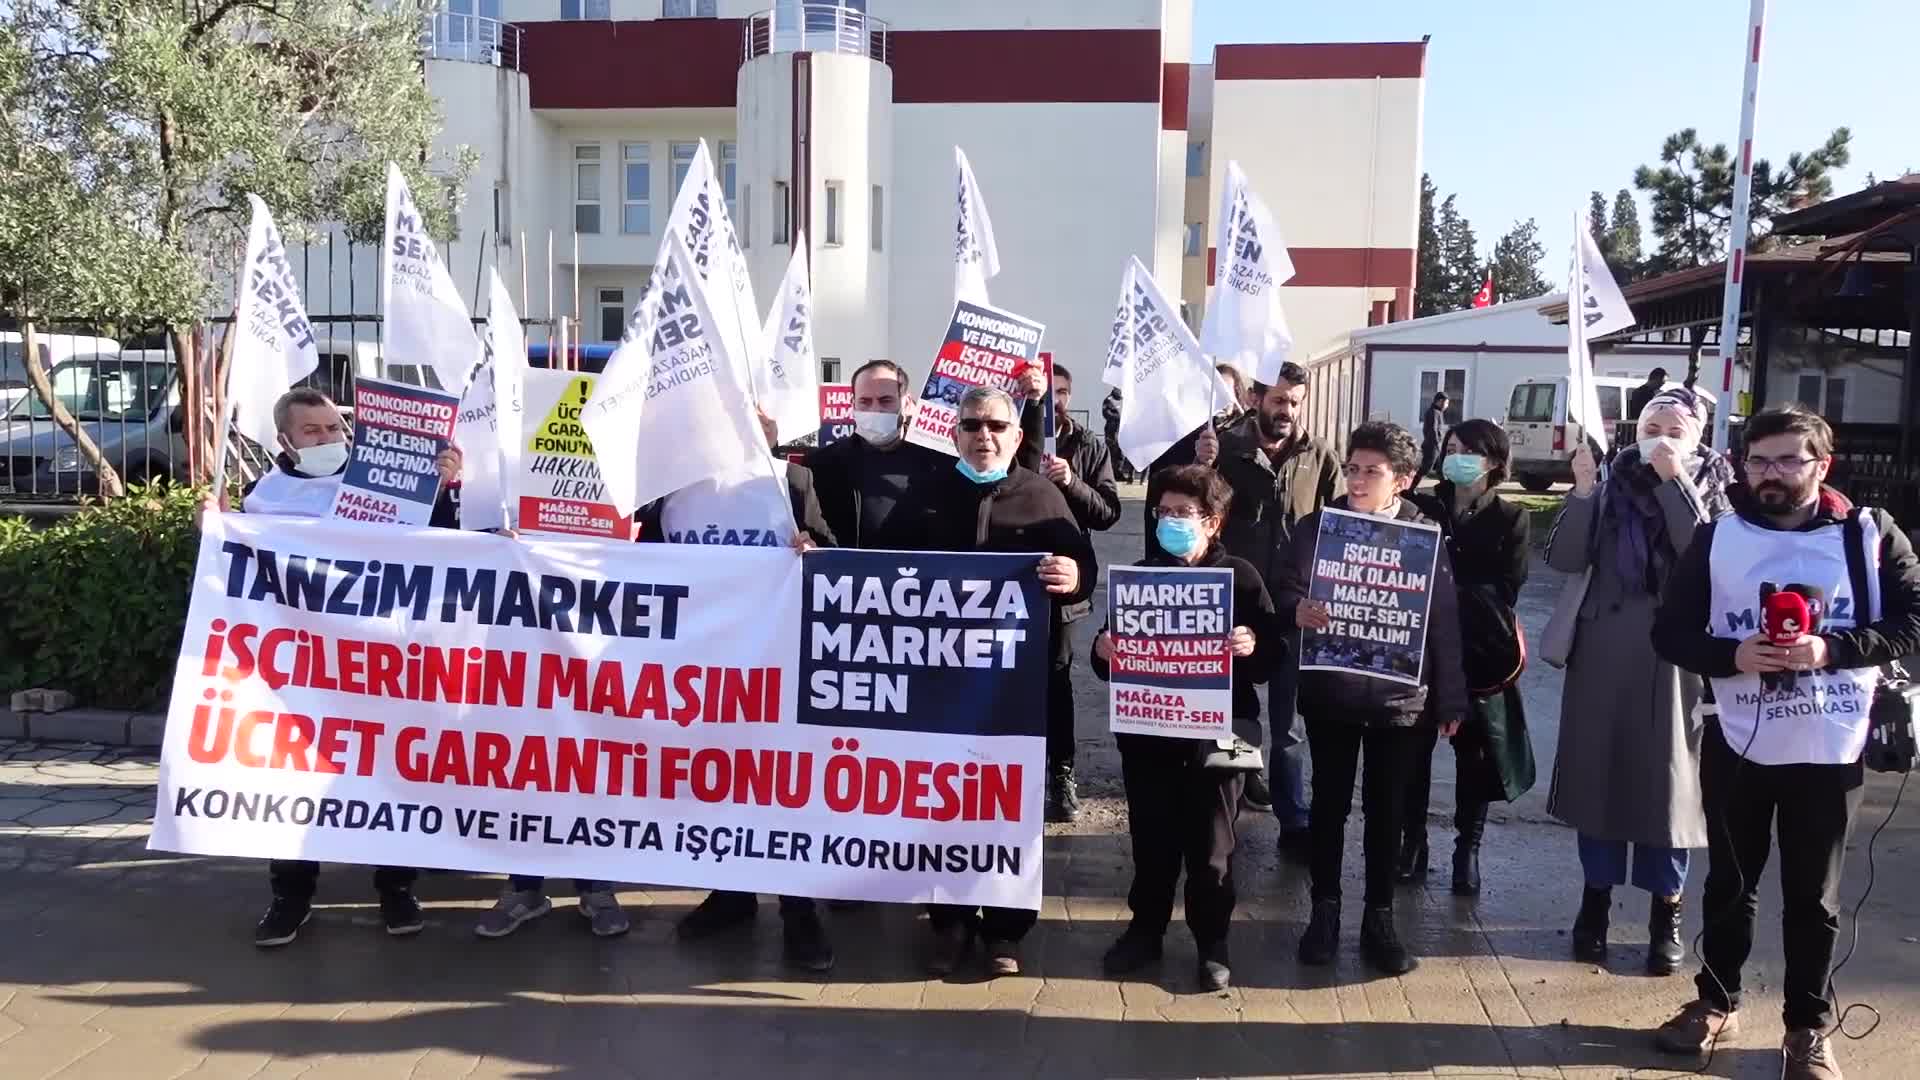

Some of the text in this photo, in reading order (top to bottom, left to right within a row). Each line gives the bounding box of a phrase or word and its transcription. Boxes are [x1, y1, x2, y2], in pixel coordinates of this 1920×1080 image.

[957, 310, 1037, 344] KONKORDATO
[963, 329, 979, 345] VE
[936, 358, 1022, 393] KORUNSUN
[358, 391, 452, 419] KONKORDATO
[826, 392, 853, 405] HAK
[823, 407, 854, 420] ALM
[548, 422, 589, 438] GARA
[916, 418, 953, 438] MARK
[536, 437, 595, 455] FONU'N
[356, 445, 439, 476] TARAFINDA
[368, 468, 418, 492] OLSUN
[340, 491, 397, 516] MAĞAZA
[539, 501, 588, 516] MAĞAZA
[538, 512, 614, 529] MARKET-SEN
[1367, 567, 1426, 592] OLALIM
[440, 567, 689, 640] MARKET
[812, 566, 1030, 620] MAĞAZA
[1116, 583, 1224, 606] MARKET
[1322, 601, 1421, 628] ARKET-SEN'E
[811, 621, 1027, 669] MARKET
[1350, 623, 1411, 646] OLALIM!
[1117, 639, 1223, 656] ASLA YALNIZ
[1117, 655, 1223, 674] YÜRÜMEYECEK
[537, 653, 782, 728] MAAŞINI
[810, 669, 909, 714] SEN
[1116, 688, 1185, 708] MAĞAZA
[1812, 682, 1865, 698] MARK
[1115, 704, 1224, 724] MARKET-SEN
[187, 687, 384, 777] ÜCRET
[660, 746, 813, 810] FONU
[175, 787, 443, 834] KONKORDATO
[455, 808, 500, 840] VE
[821, 835, 1021, 876] KORUNSUN
